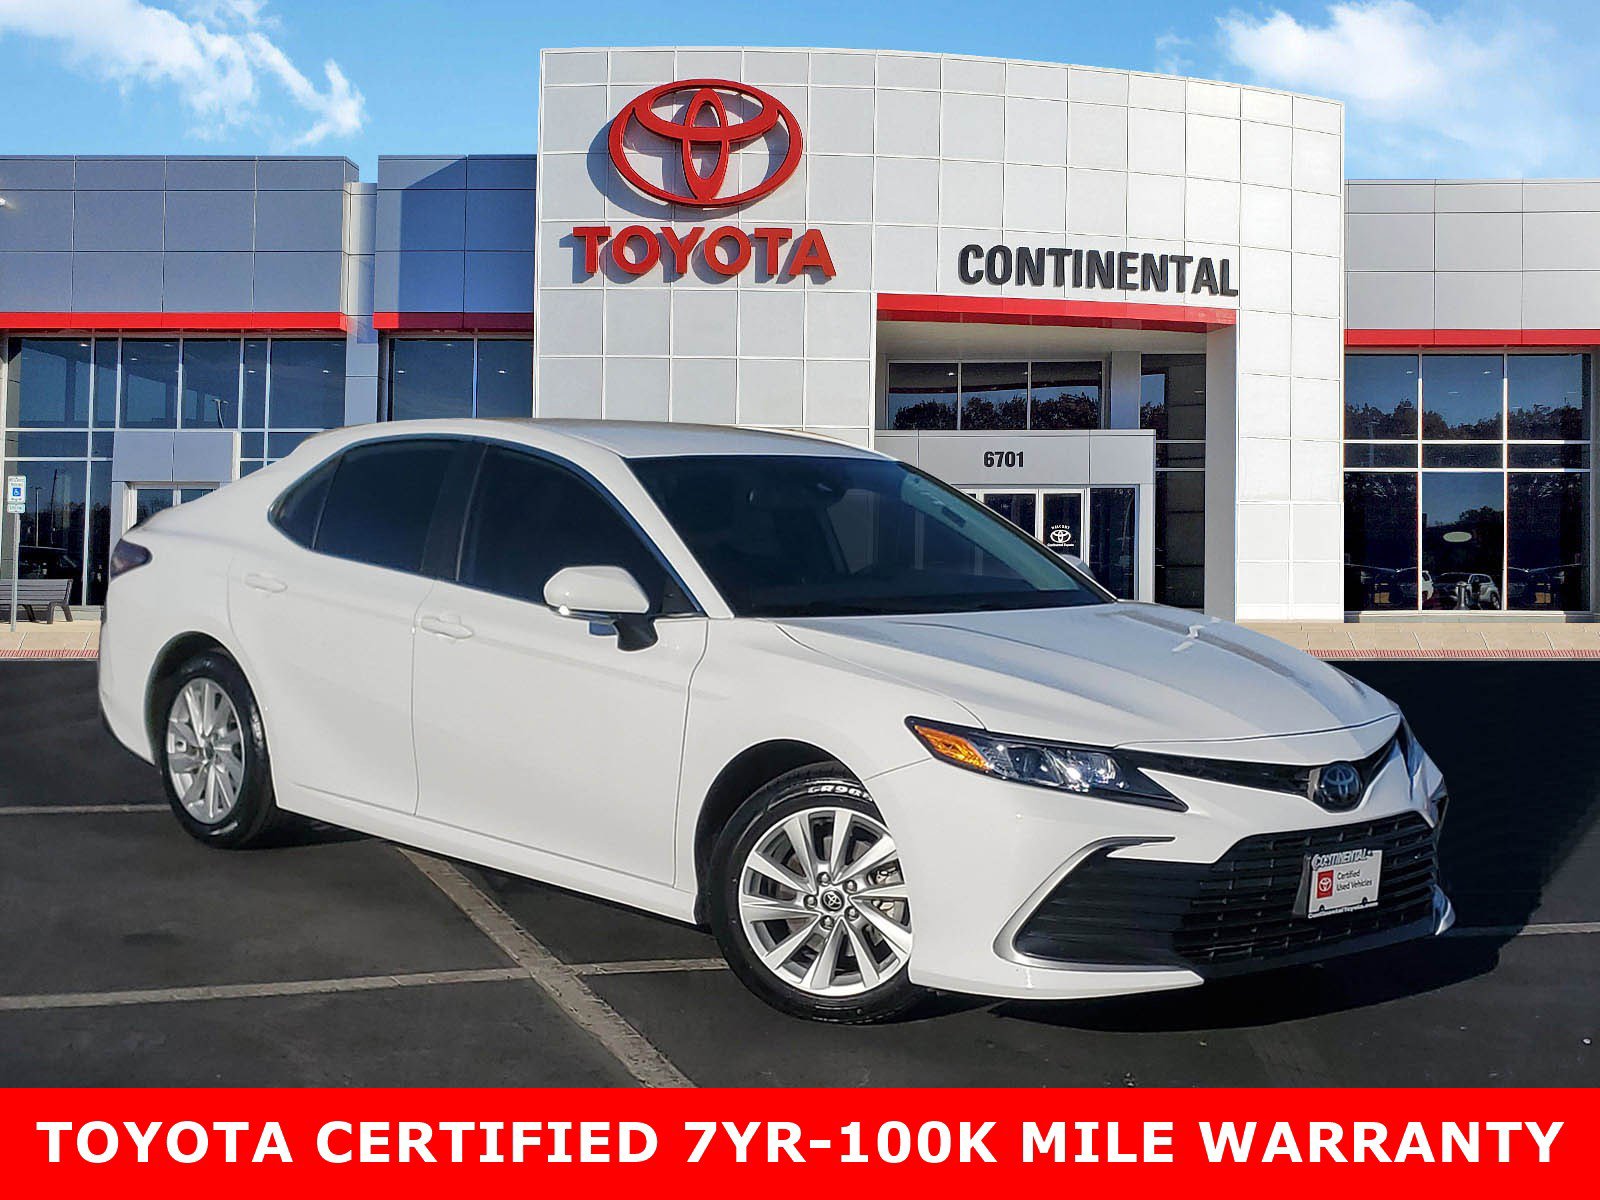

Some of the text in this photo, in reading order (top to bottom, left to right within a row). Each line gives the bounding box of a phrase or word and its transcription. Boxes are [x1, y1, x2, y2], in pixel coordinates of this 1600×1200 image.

[573, 226, 836, 277] TOYOTA
[958, 244, 1239, 297] CONTINENTAL
[983, 451, 1024, 468] 6701
[1337, 870, 1360, 880] Certified
[1337, 880, 1372, 891] Used Vehicles
